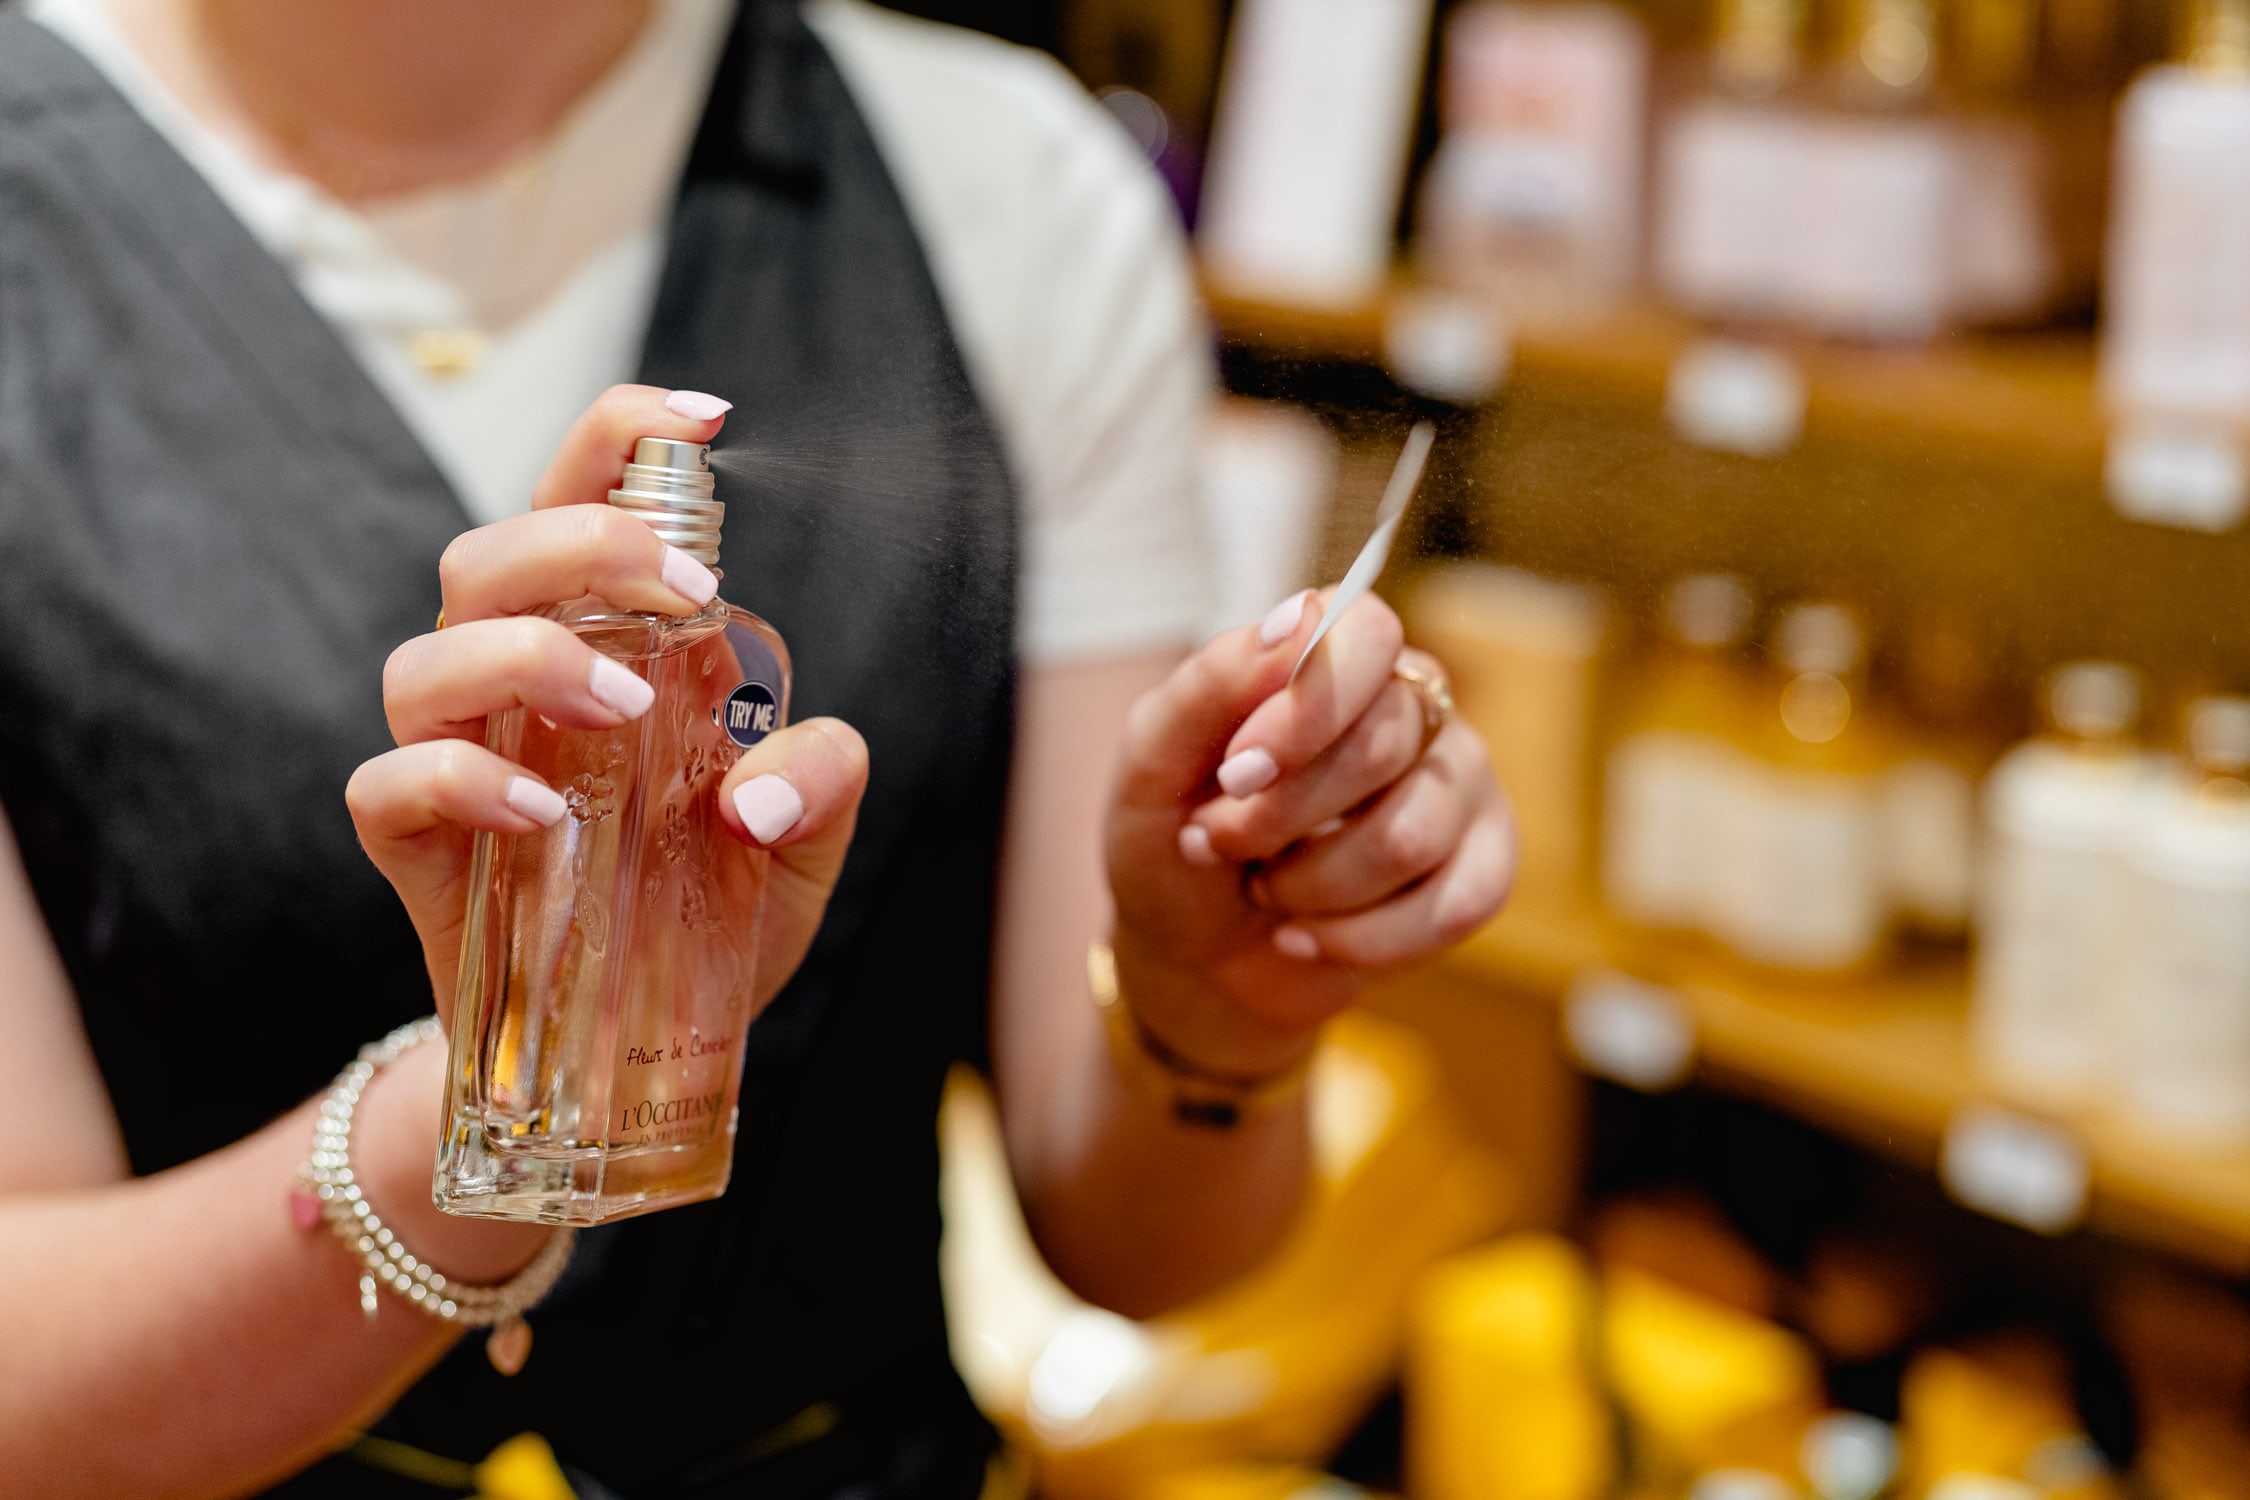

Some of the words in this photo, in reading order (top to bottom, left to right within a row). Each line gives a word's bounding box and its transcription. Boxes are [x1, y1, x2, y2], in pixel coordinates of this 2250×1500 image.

[730, 700, 754, 729] TRY
[752, 703, 774, 732] ME
[671, 1037, 683, 1060] de
[639, 1134, 651, 1145] EN
